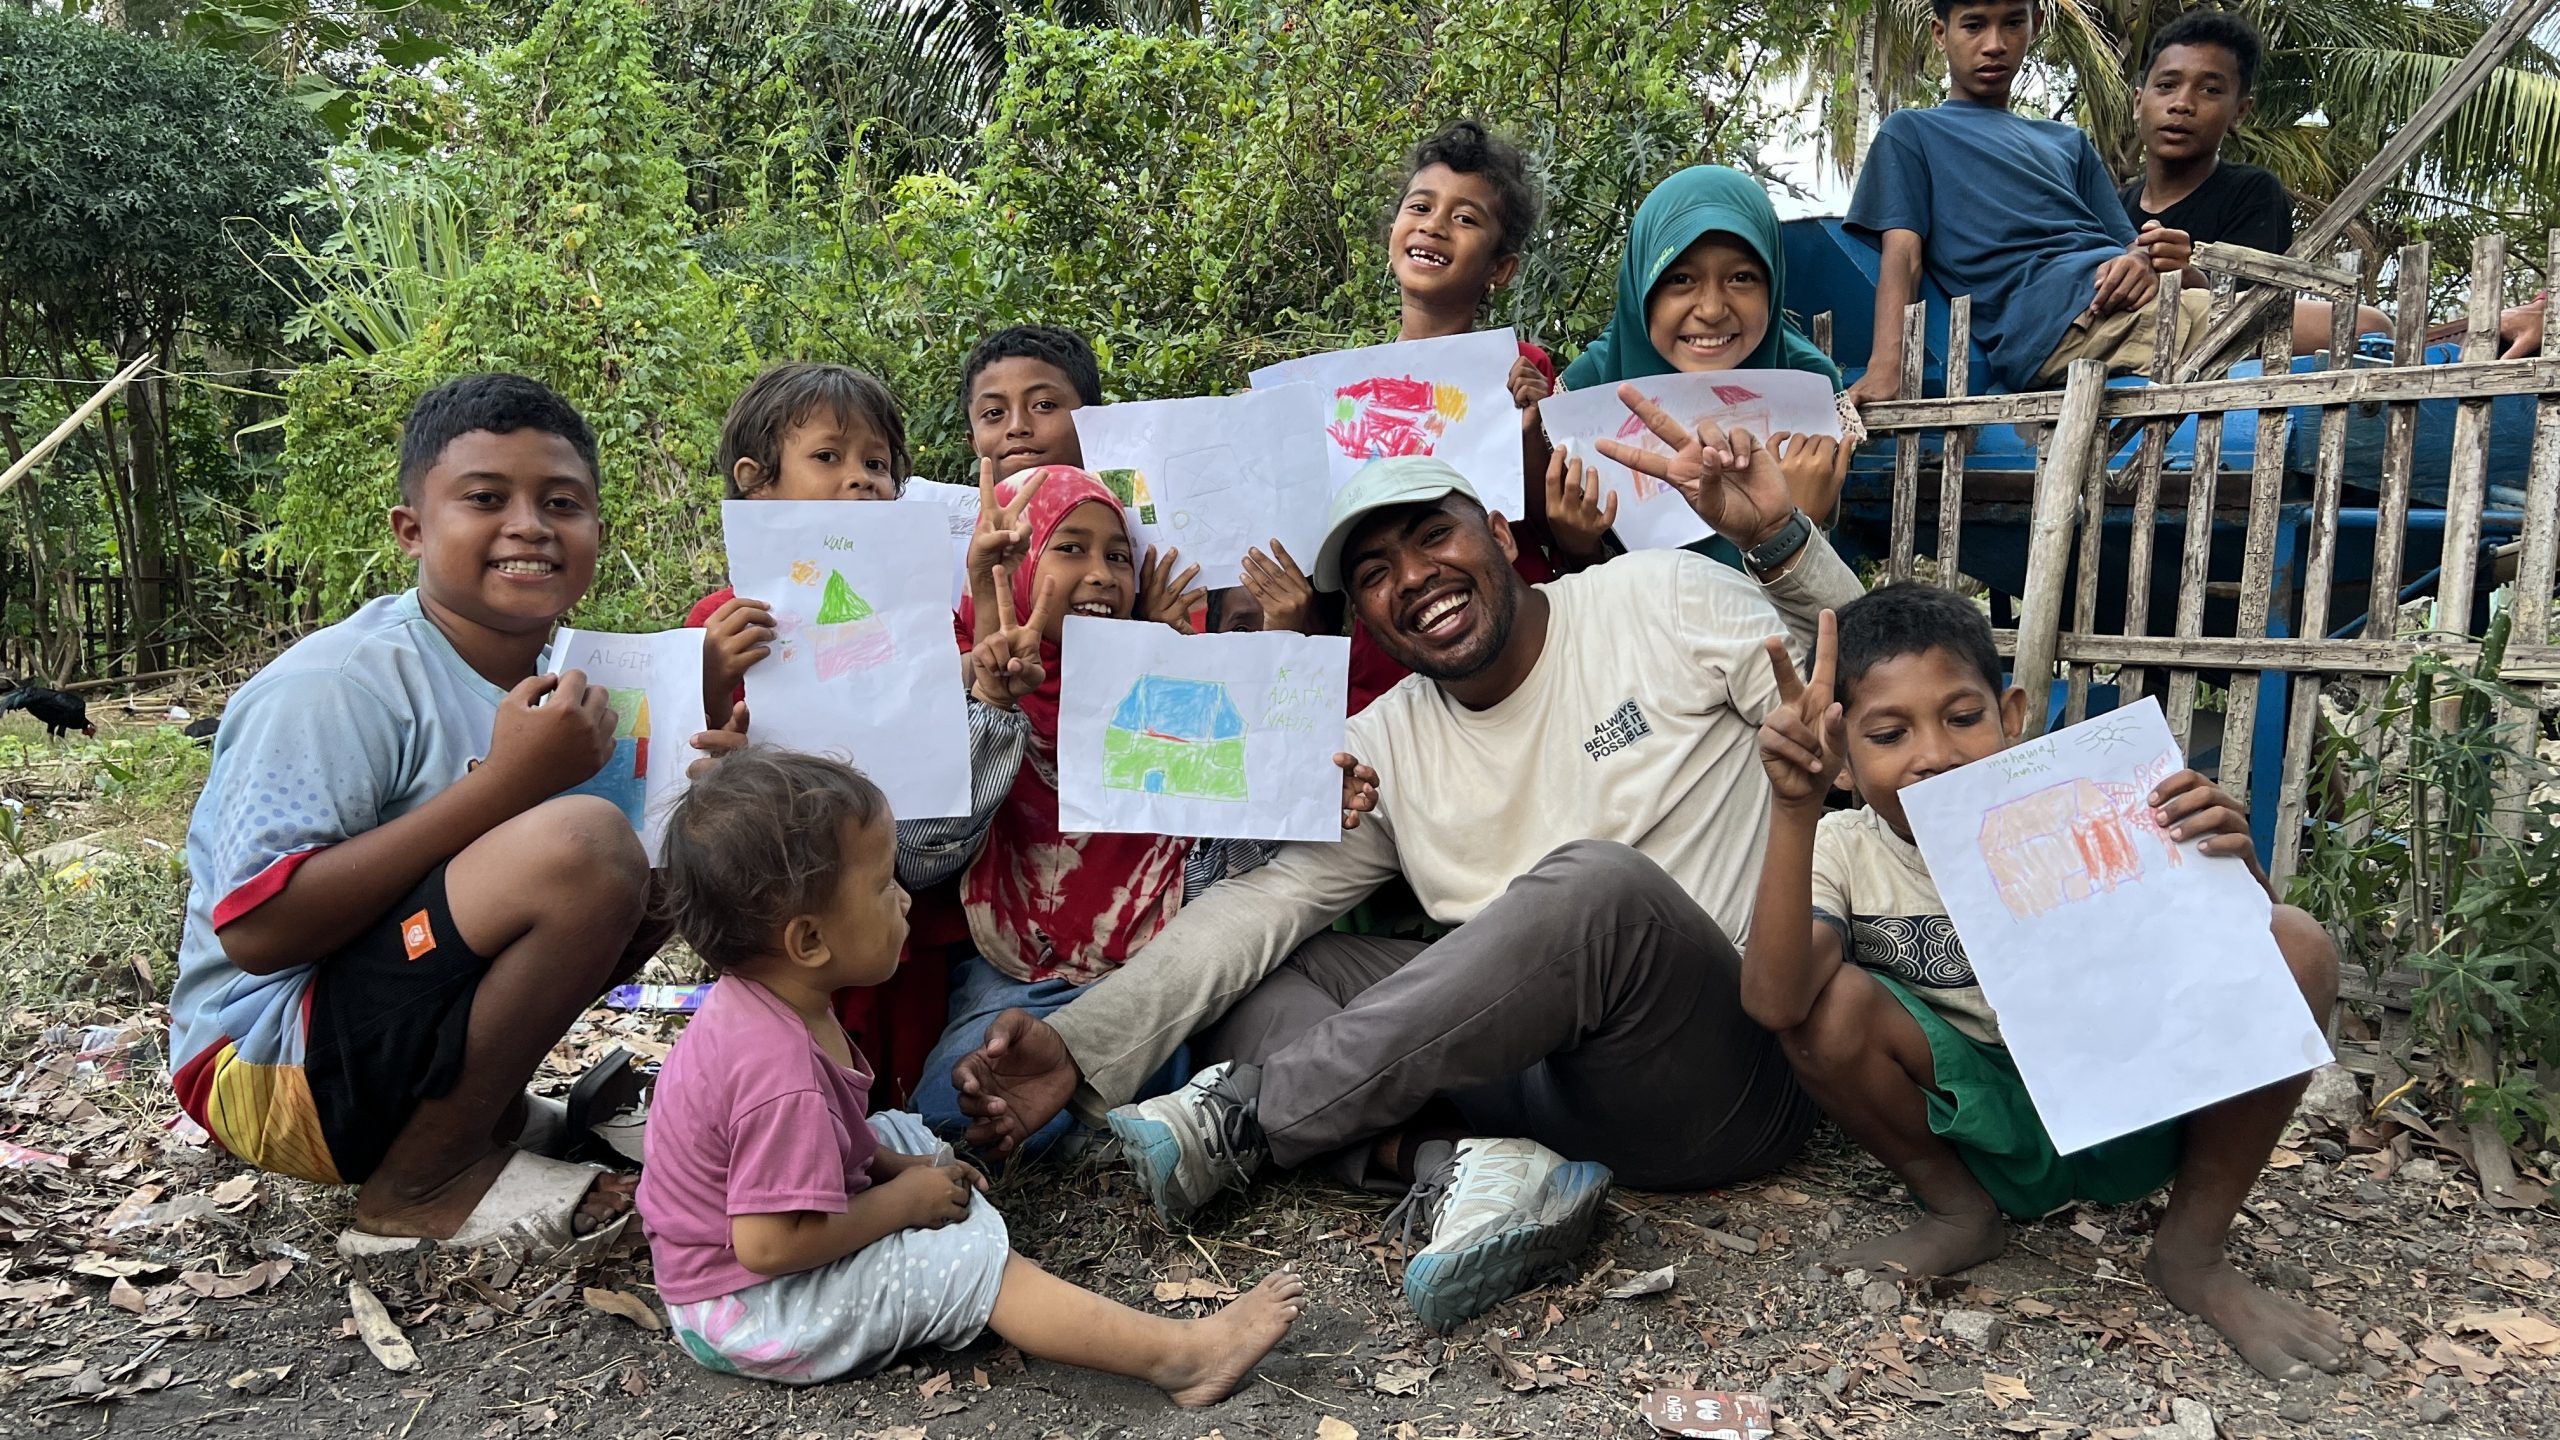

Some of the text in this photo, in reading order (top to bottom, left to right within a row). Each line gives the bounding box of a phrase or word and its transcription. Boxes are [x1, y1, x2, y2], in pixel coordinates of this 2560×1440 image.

[1584, 711, 1642, 753] BELIEVE IT
[1594, 701, 1637, 735] ALWAYS
[1592, 722, 1650, 762] POSSIBLE
